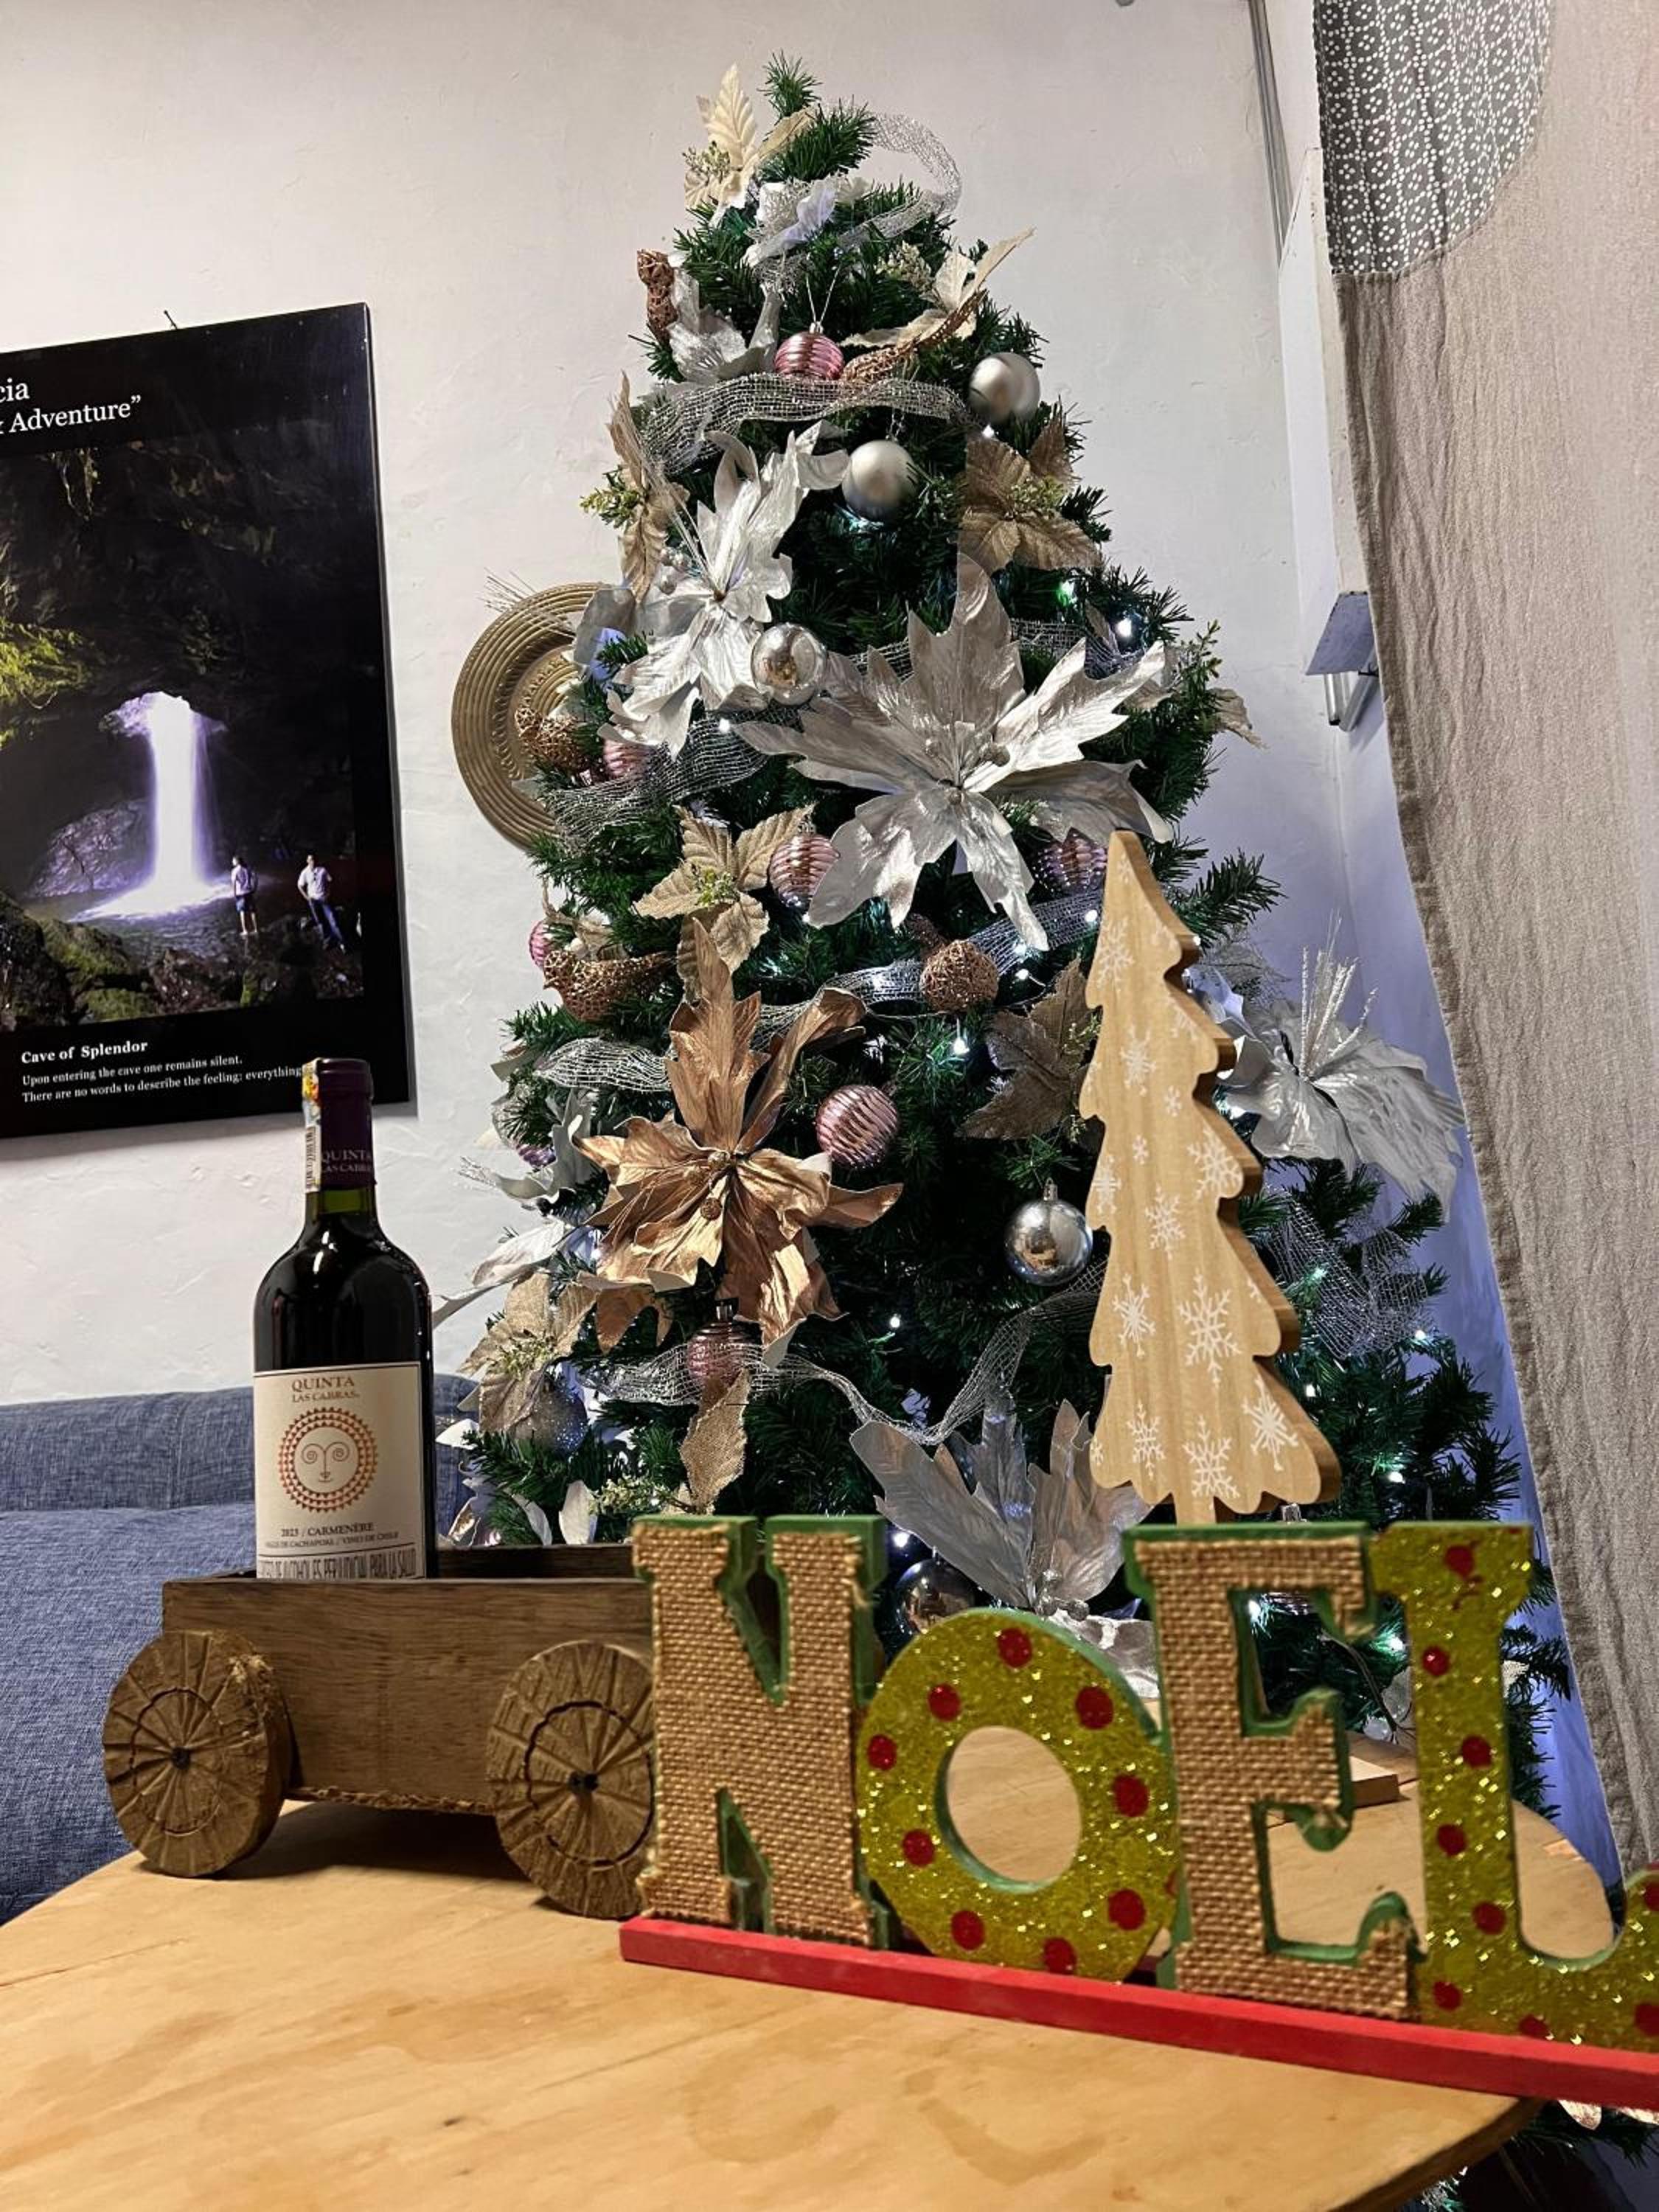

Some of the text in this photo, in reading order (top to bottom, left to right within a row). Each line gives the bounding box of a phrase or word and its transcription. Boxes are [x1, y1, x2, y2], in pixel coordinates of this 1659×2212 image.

[21, 1040, 148, 1064] Cave of Splendor
[23, 1055, 243, 1087] Upon entering the cave one remains silent.
[21, 1091, 52, 1102] There
[56, 1091, 72, 1099] are
[75, 1088, 88, 1097] no
[90, 1082, 122, 1095] words
[124, 1082, 135, 1092] to
[138, 1077, 181, 1091] describe
[184, 1075, 201, 1086] the
[292, 1376, 355, 1393] QUINTA
[631, 1515, 1659, 2054] NOEL
